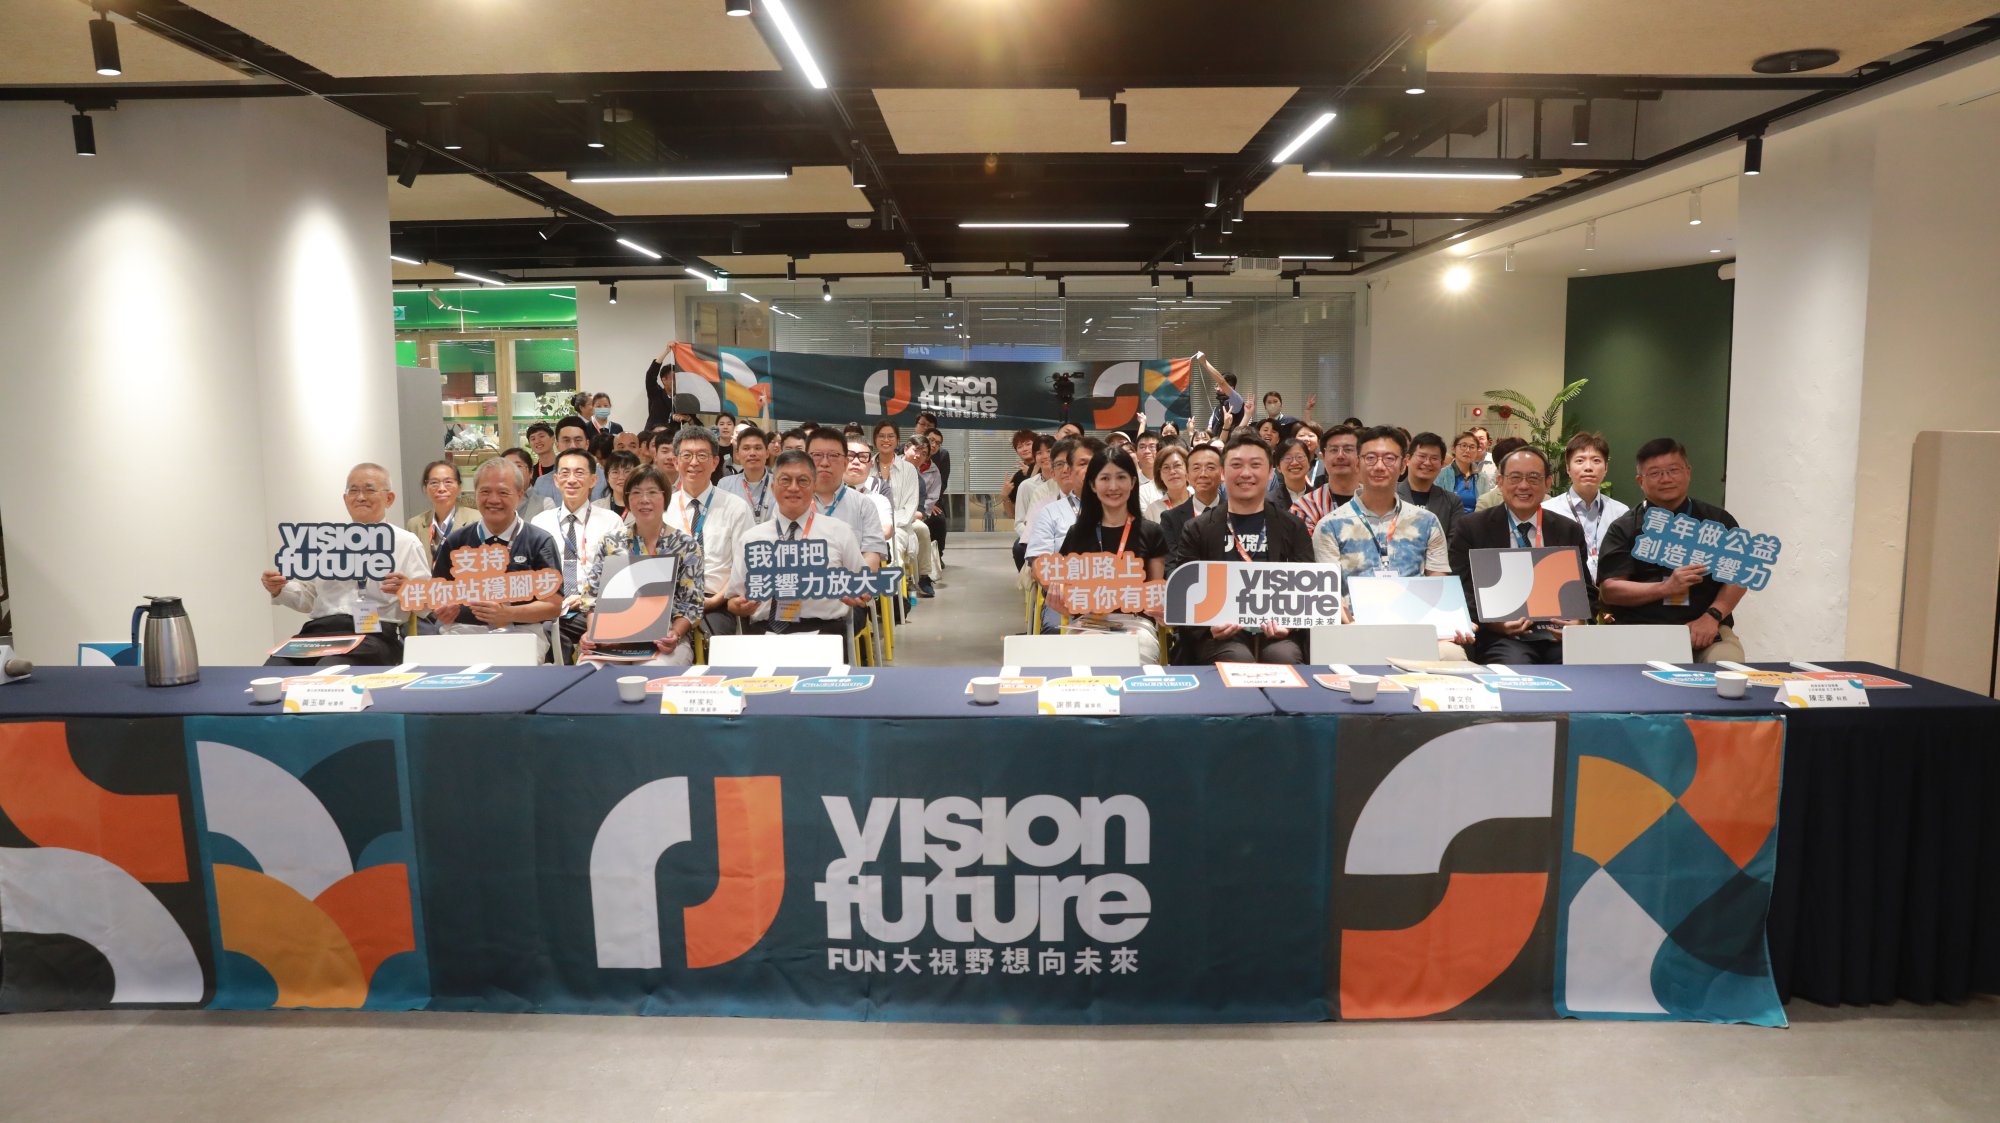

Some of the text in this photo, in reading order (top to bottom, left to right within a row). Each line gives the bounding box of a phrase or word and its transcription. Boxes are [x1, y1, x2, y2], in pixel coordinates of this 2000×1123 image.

[920, 375, 998, 395] vision
[917, 391, 999, 412] future
[281, 526, 392, 551] vision
[1645, 509, 1778, 562] 青年做公益
[277, 550, 393, 578] future
[453, 547, 508, 574] 支持
[748, 542, 826, 569] 我們把
[1040, 555, 1142, 581] 社創路上
[1634, 536, 1767, 588] 創造影響力
[401, 573, 560, 608] 伴你站穩腳步
[748, 569, 902, 599] 影響力放大了
[1239, 569, 1339, 593] vision
[1067, 583, 1166, 611] 有你有我
[1235, 588, 1340, 617] future
[821, 794, 1151, 867] vision
[814, 858, 1152, 943] future
[828, 946, 1140, 976] FUN大視野想向未來
